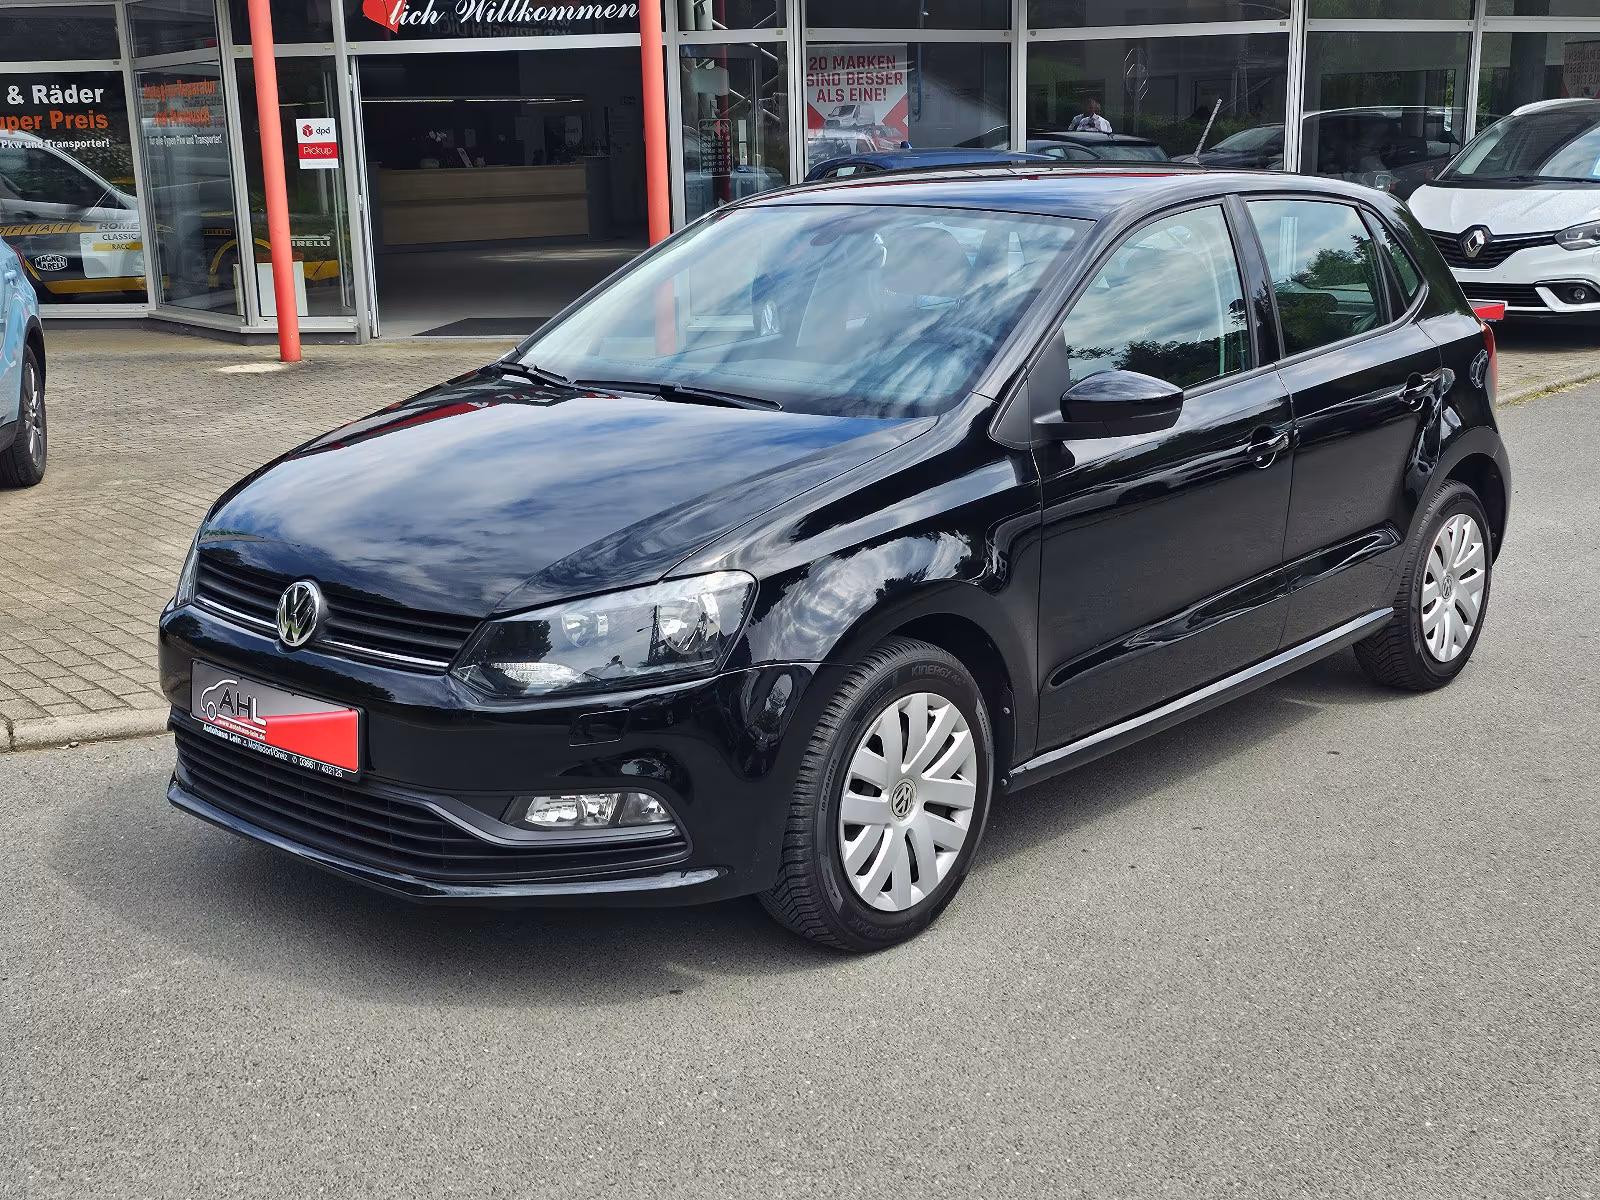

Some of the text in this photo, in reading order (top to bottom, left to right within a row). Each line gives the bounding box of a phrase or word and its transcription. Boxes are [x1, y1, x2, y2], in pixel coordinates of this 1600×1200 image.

[455, 0, 640, 23] Willkommen
[809, 55, 896, 71] 20 MARKEN
[807, 71, 903, 87] SIND BESSER
[6, 84, 104, 104] & Räder
[816, 87, 887, 103] ALS EINE!
[0, 109, 109, 135] uper Preis
[315, 126, 331, 136] dpd
[44, 138, 110, 150] Transporter!
[303, 146, 333, 156] Pickup
[102, 233, 137, 241] CLASSIC
[911, 664, 953, 678] KINERGY
[218, 687, 267, 727] AHL
[202, 723, 229, 740] Autohaus
[229, 732, 242, 745] Lein
